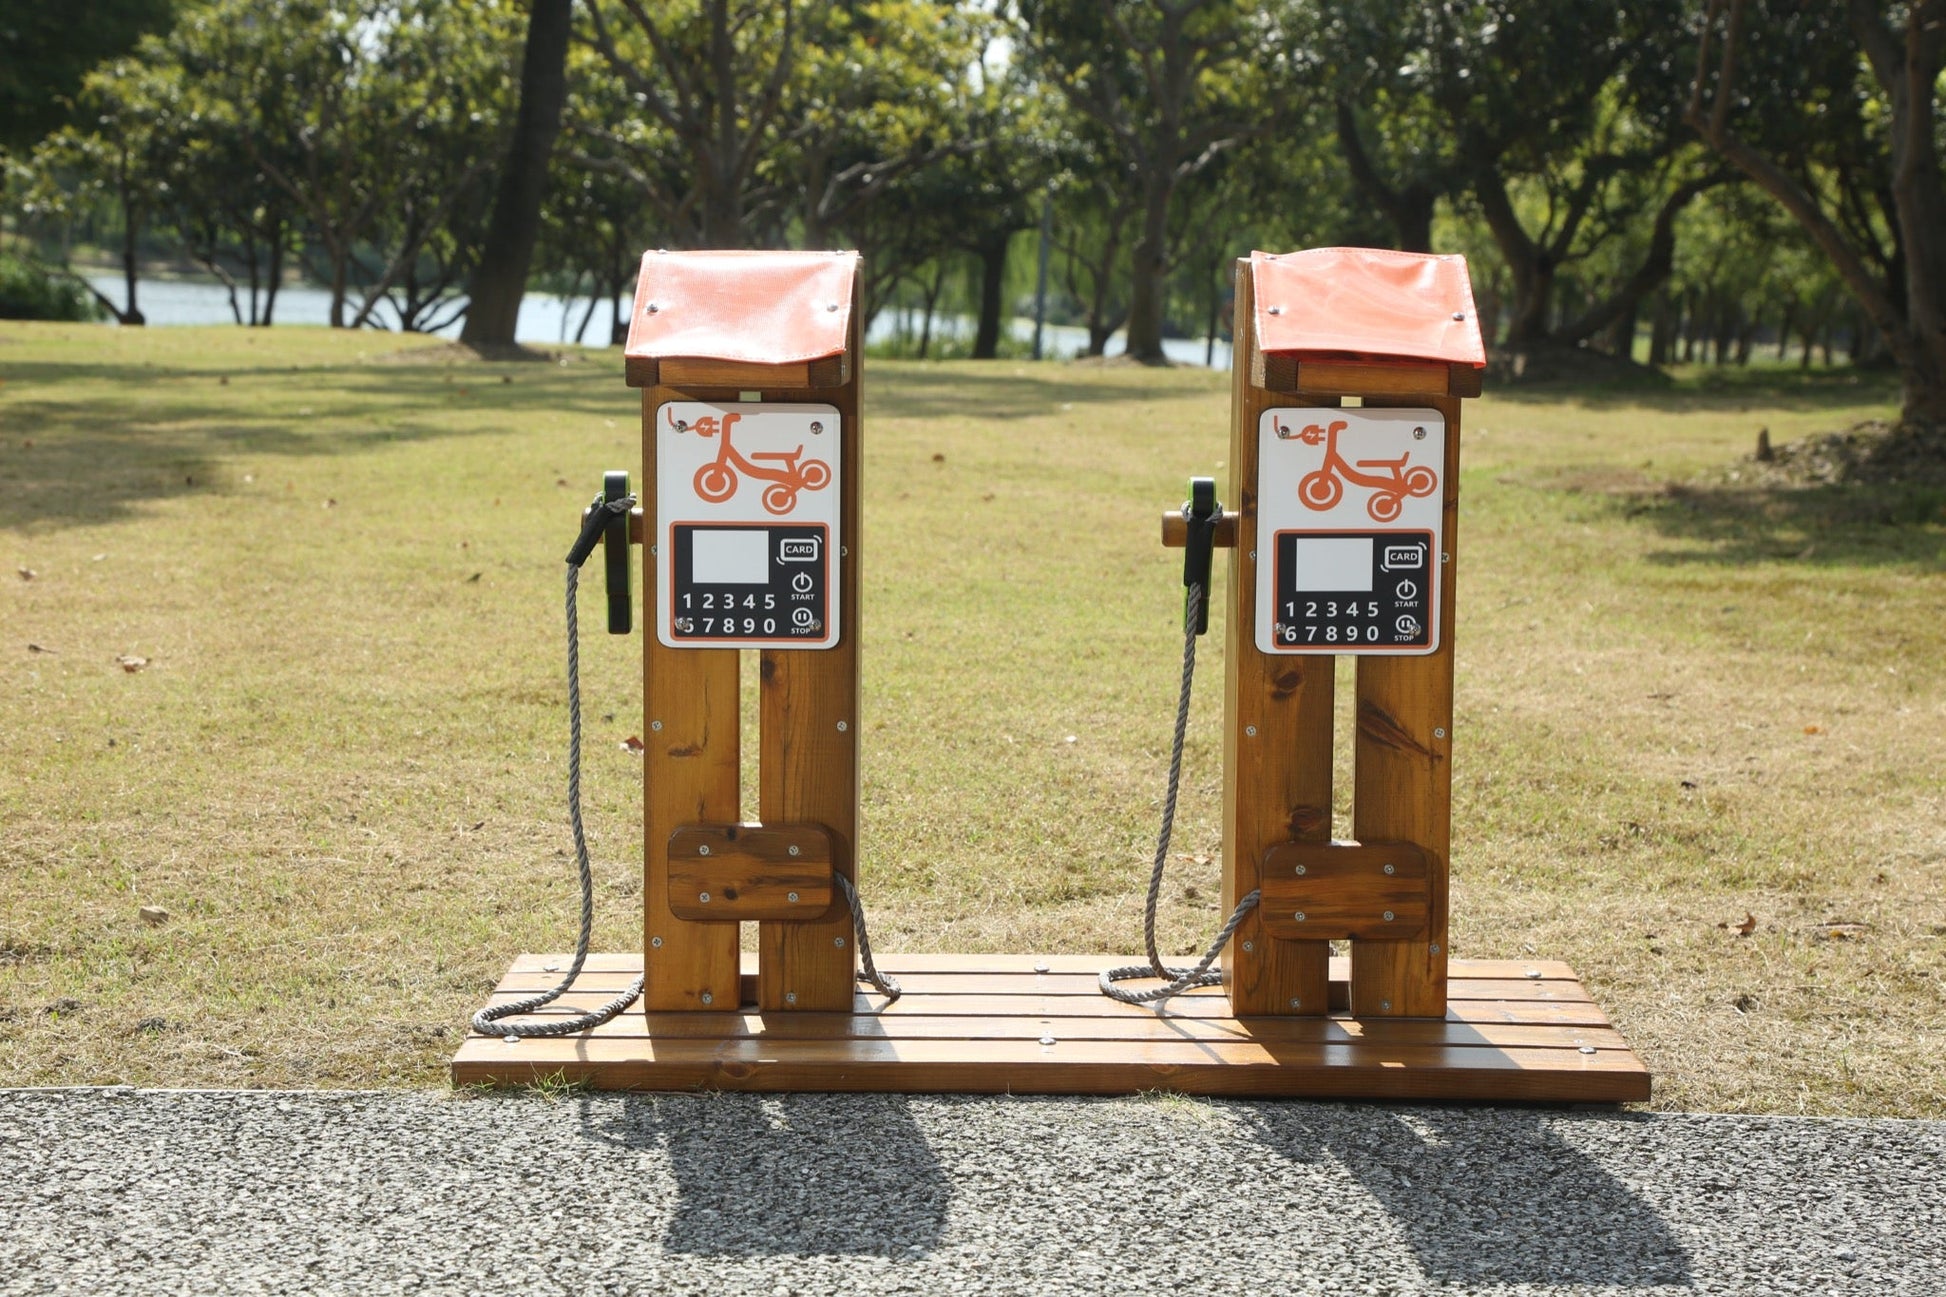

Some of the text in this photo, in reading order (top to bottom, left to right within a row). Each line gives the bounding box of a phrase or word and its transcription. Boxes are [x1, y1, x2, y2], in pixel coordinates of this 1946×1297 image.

[785, 545, 813, 554] CARD
[1389, 552, 1418, 561] CARD
[682, 592, 776, 610] 1 2 3 4 5
[790, 593, 815, 601] START
[1285, 601, 1379, 618] 1 2 3 4 5
[702, 617, 715, 633] 7
[722, 617, 735, 634] 8
[743, 617, 756, 634] 9
[763, 617, 776, 634] 0
[790, 627, 811, 635] STOP
[1284, 625, 1379, 642] 6 7 8 9 0
